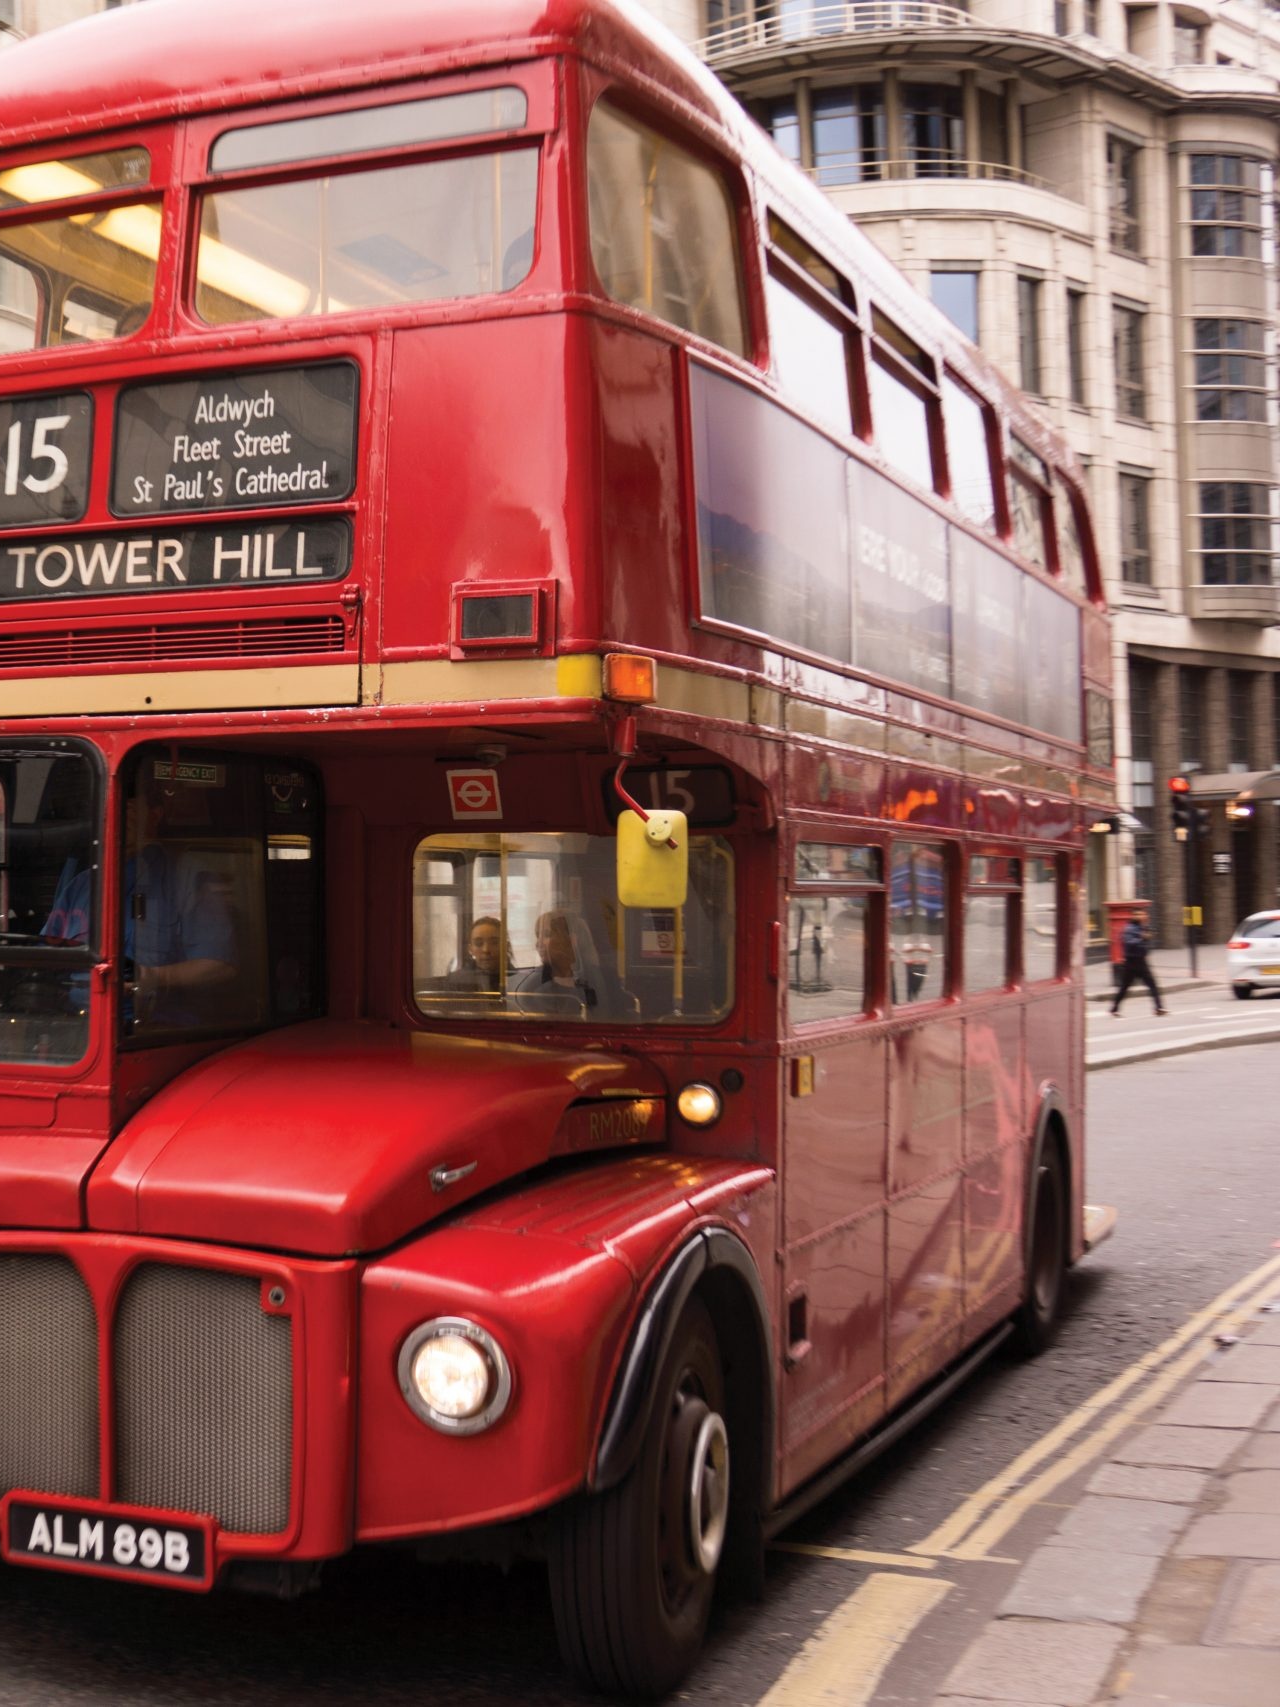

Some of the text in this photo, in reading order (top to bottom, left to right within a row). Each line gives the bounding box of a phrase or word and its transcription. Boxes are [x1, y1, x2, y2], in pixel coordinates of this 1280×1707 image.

[194, 389, 275, 428] Aldwych
[4, 414, 71, 496] 15
[173, 429, 292, 464] Fleet Street
[132, 460, 329, 504] St Paul's Cathedral
[7, 531, 323, 590] TOWER HILL
[649, 769, 696, 815] 15
[590, 1107, 649, 1143] RM2089
[27, 1512, 190, 1573] ALM 89B
